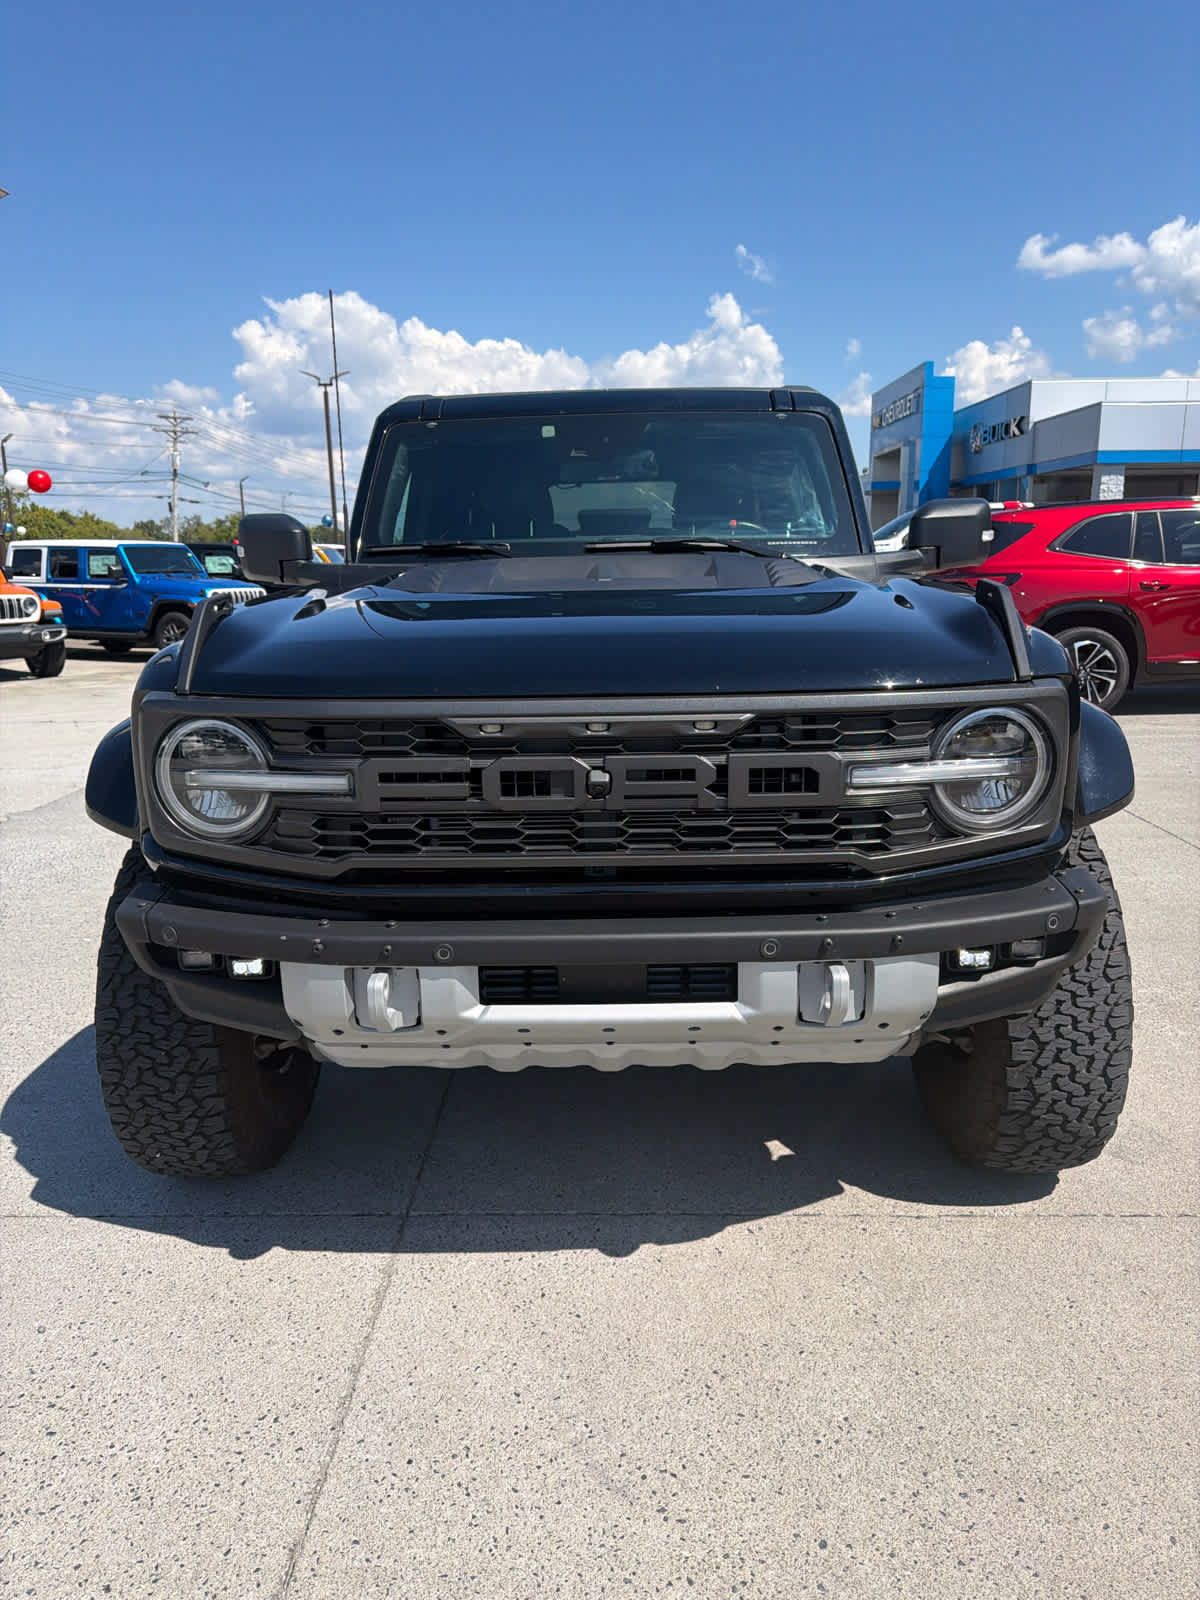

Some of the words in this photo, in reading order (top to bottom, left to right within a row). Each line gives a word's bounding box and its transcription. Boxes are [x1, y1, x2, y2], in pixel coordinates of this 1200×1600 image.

[881, 393, 915, 427] CHEVROLET
[981, 415, 1022, 446] BUICK
[358, 753, 842, 811] FORD
